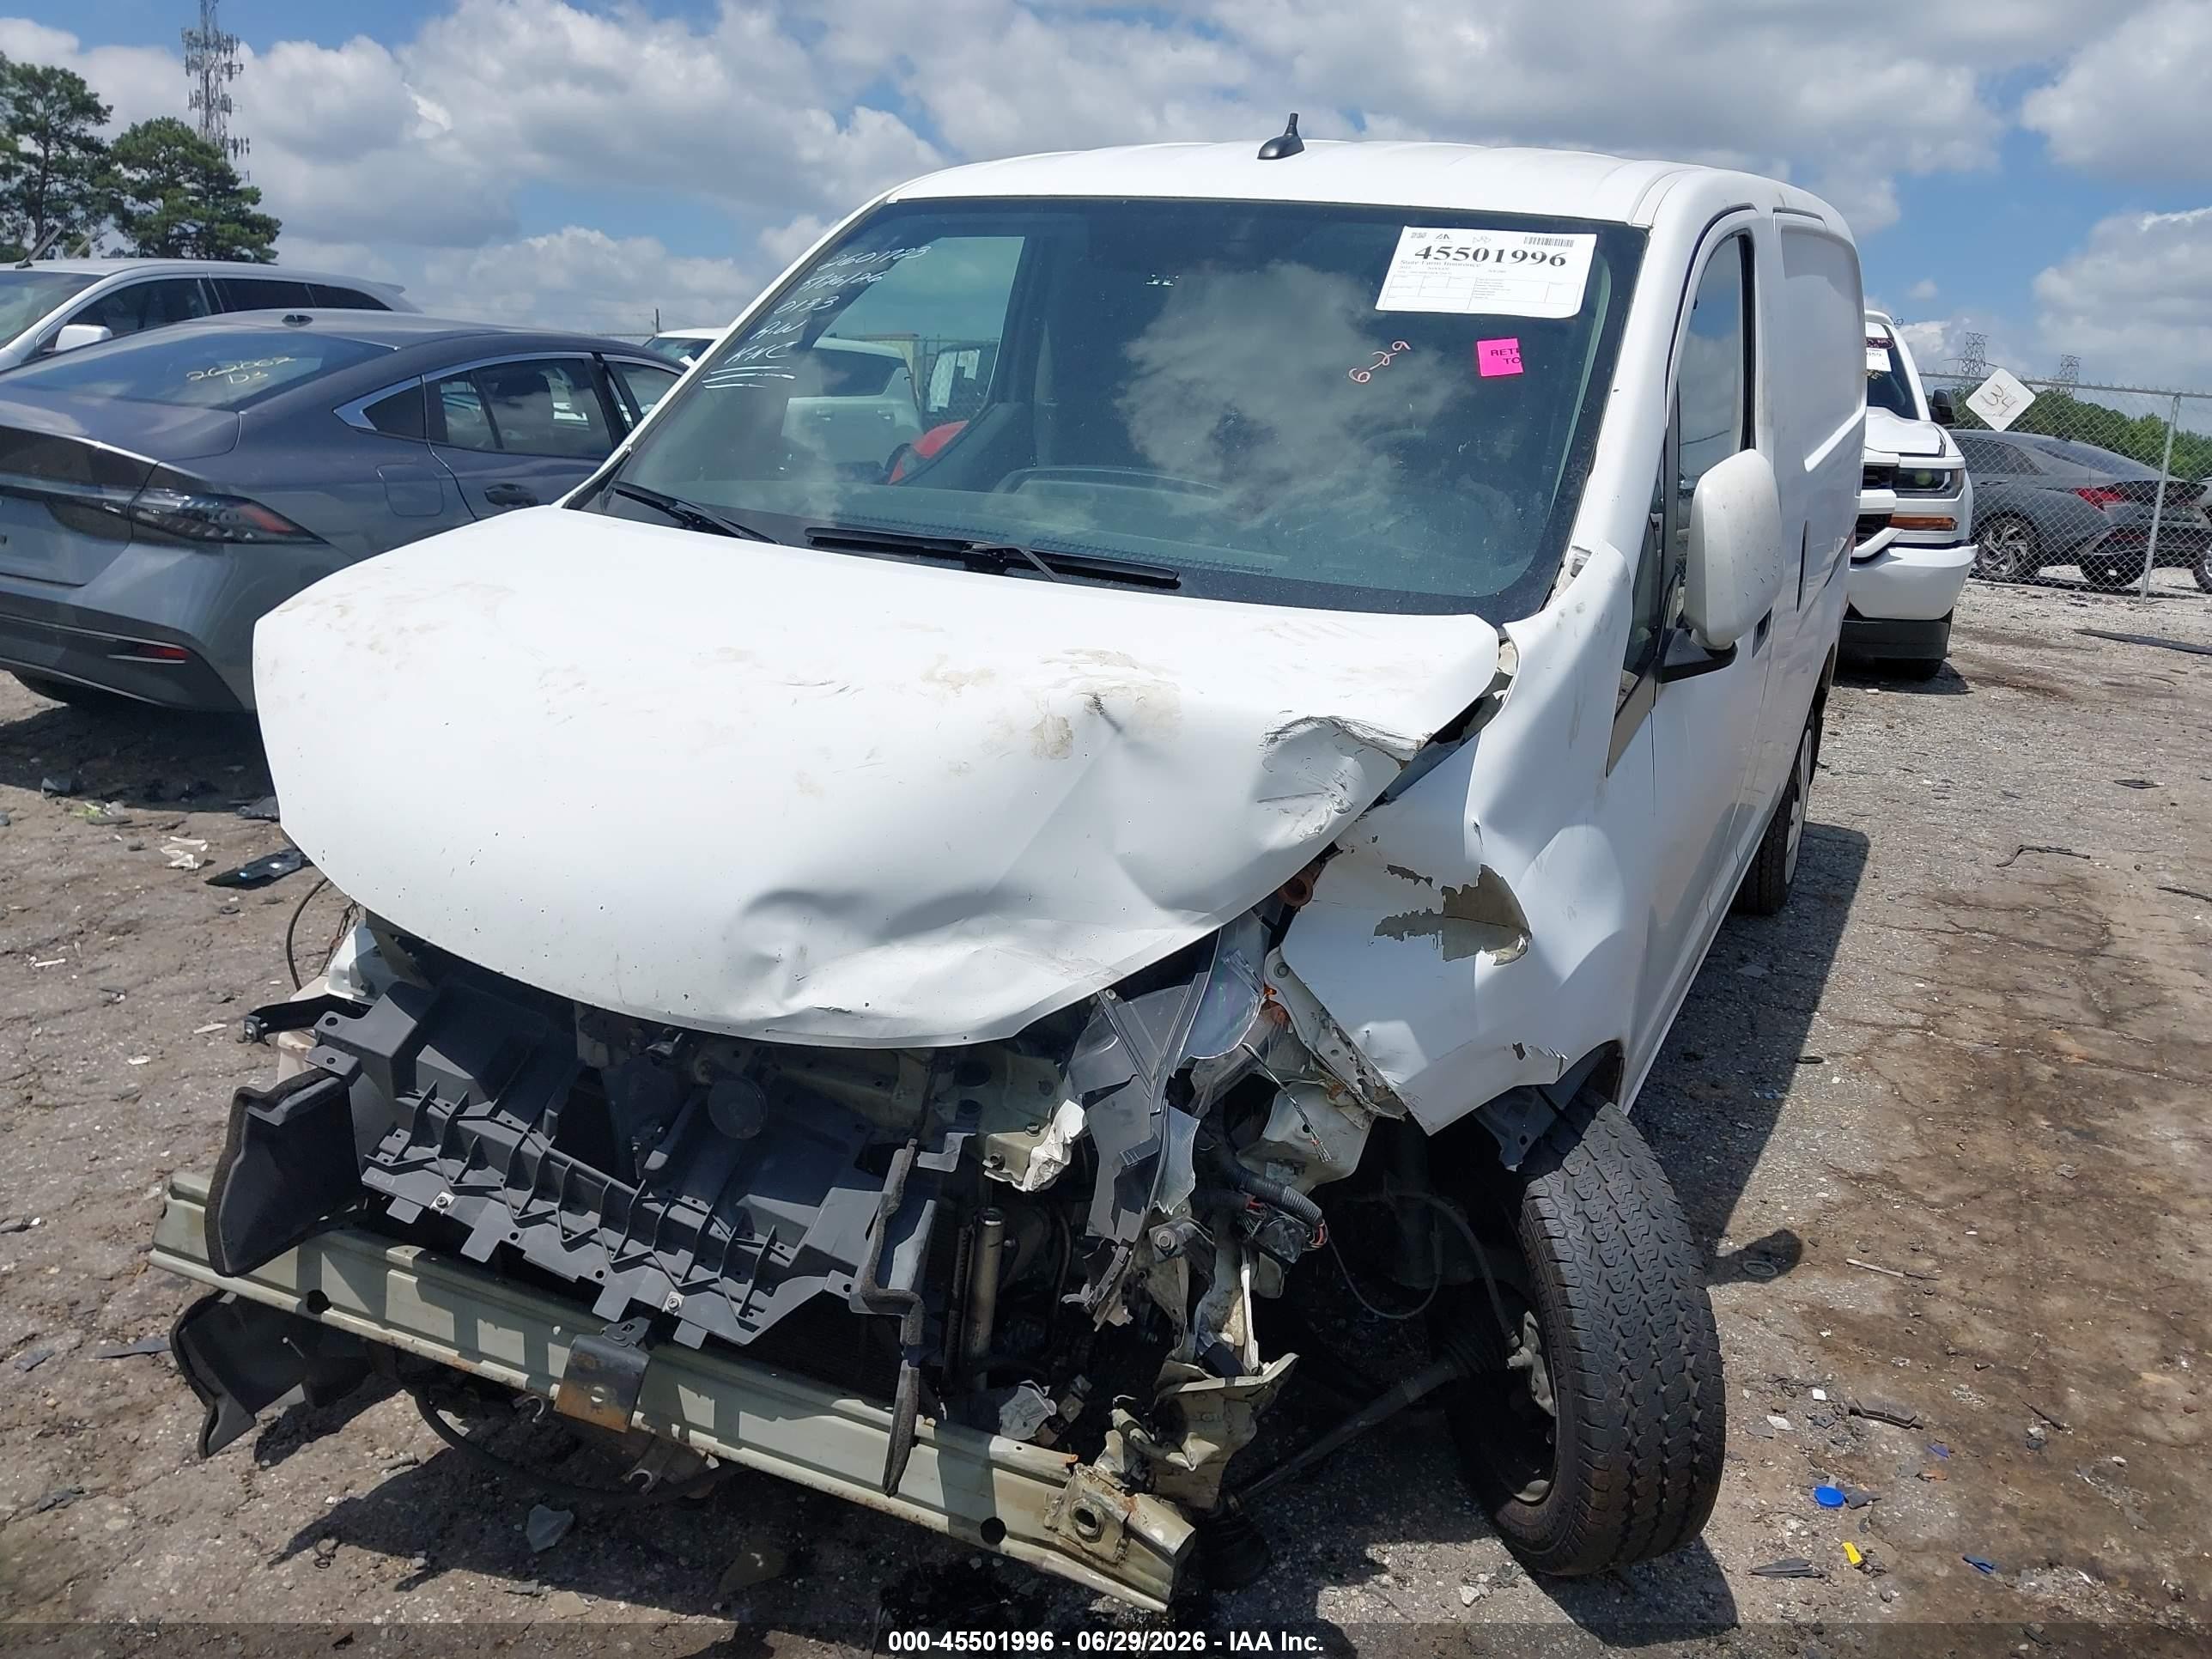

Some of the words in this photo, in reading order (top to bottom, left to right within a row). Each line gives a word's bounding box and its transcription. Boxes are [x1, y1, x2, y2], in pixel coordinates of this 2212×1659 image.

[1414, 245, 1567, 267] 45501996
[774, 295, 840, 314] 0133
[1491, 348, 1519, 356] RET
